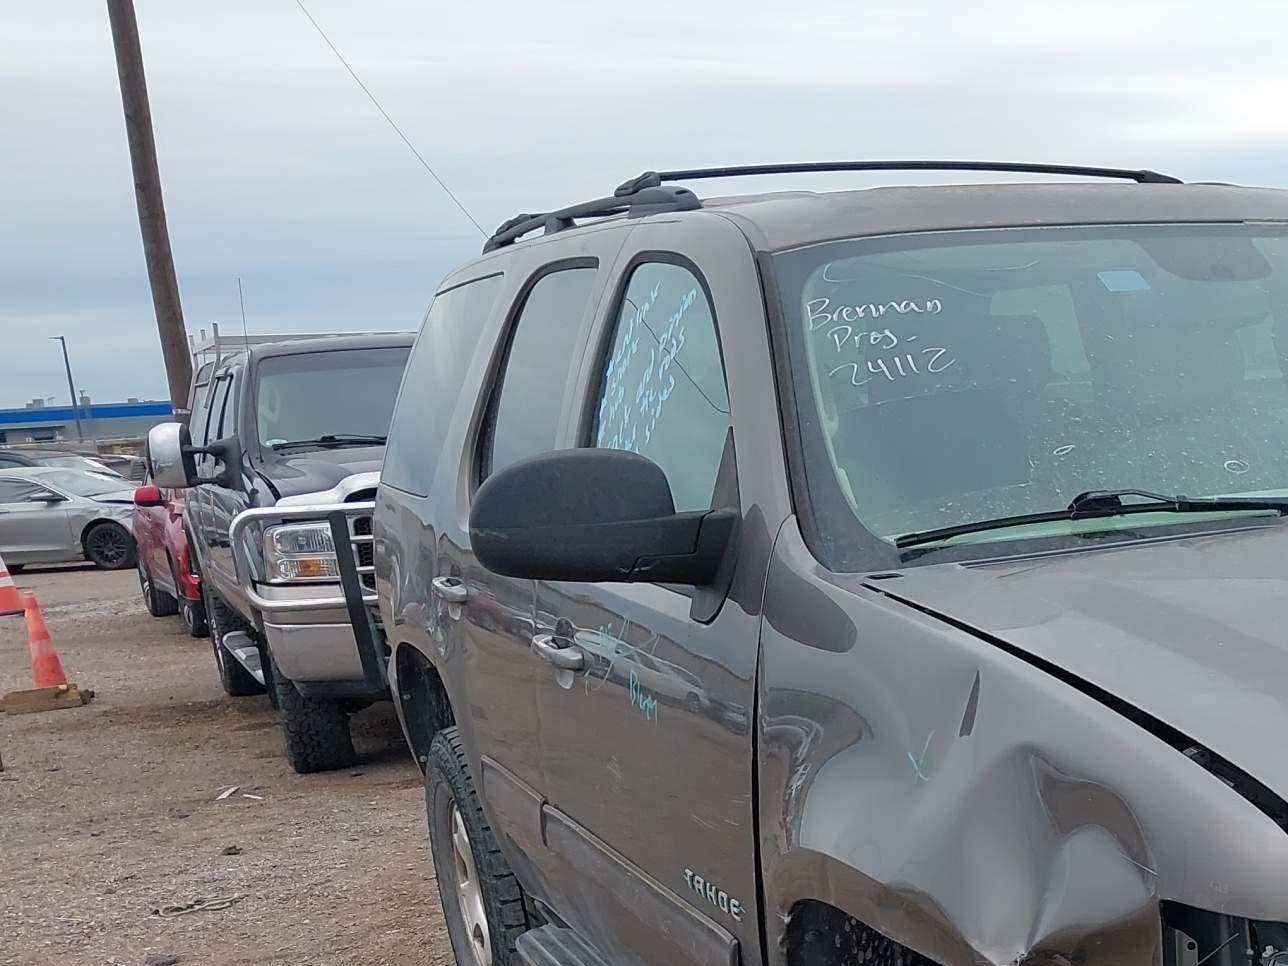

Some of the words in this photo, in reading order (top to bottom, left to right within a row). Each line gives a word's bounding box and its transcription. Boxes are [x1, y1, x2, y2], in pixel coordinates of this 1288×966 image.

[807, 298, 942, 330] Brennan
[828, 348, 956, 386] 24112
[682, 868, 746, 922] TAHOE
